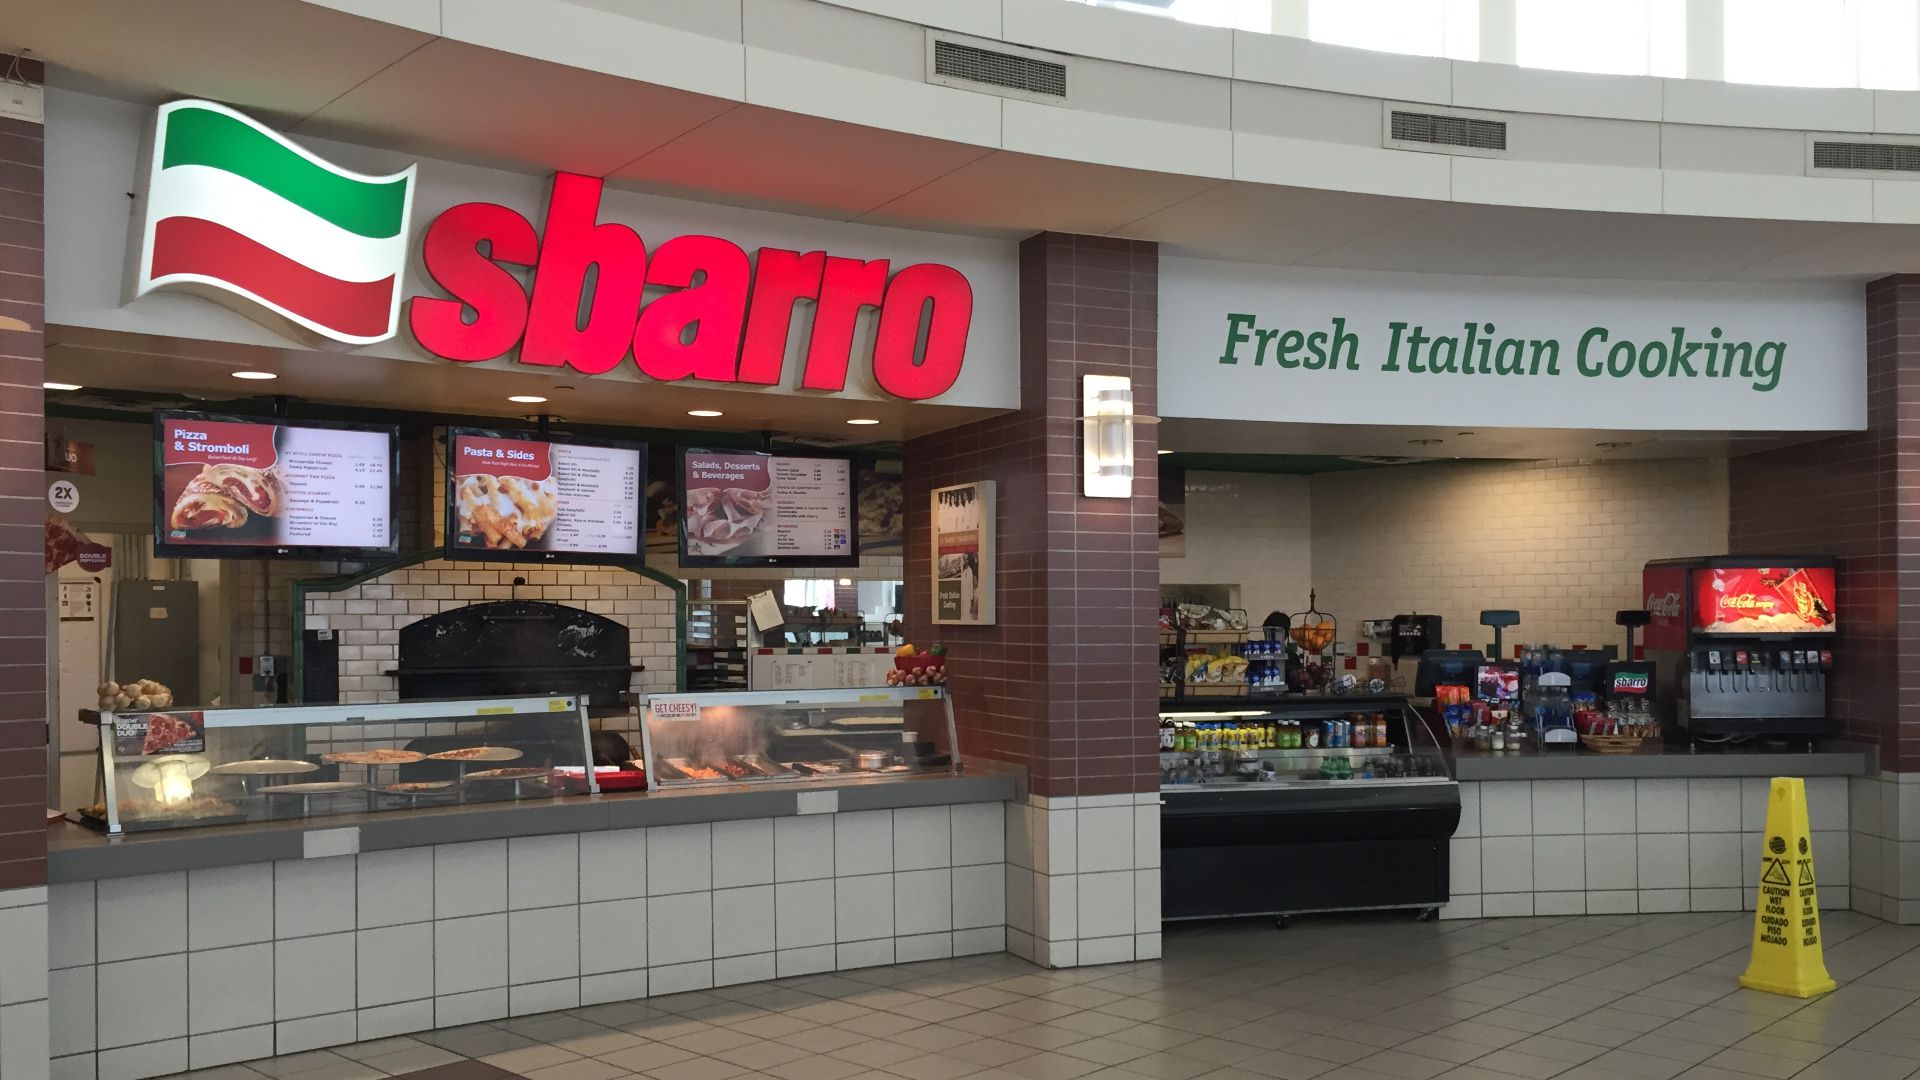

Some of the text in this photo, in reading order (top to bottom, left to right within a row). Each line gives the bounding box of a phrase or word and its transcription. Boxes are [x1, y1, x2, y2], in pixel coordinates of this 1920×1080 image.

[409, 171, 973, 399] sbarro
[1219, 313, 1787, 392] Fresh Italian Cooking
[174, 429, 207, 440] Pizza
[174, 441, 249, 454] & Stromboli
[464, 446, 535, 460] Pasta & Sides
[692, 461, 760, 470] Salads, Desserts
[692, 471, 744, 481] & Beverages
[55, 487, 72, 499] 2X
[1615, 676, 1646, 686] sbarro
[655, 702, 697, 713] GET CHEESY!
[116, 722, 148, 730] DOUBLE
[1762, 885, 1790, 897] CAUTION
[1770, 896, 1782, 905] WET
[1765, 904, 1785, 915] FLOOR
[1761, 915, 1789, 927] CUIDADO
[1767, 926, 1781, 935] PISO
[1760, 934, 1788, 946] MOJADO
